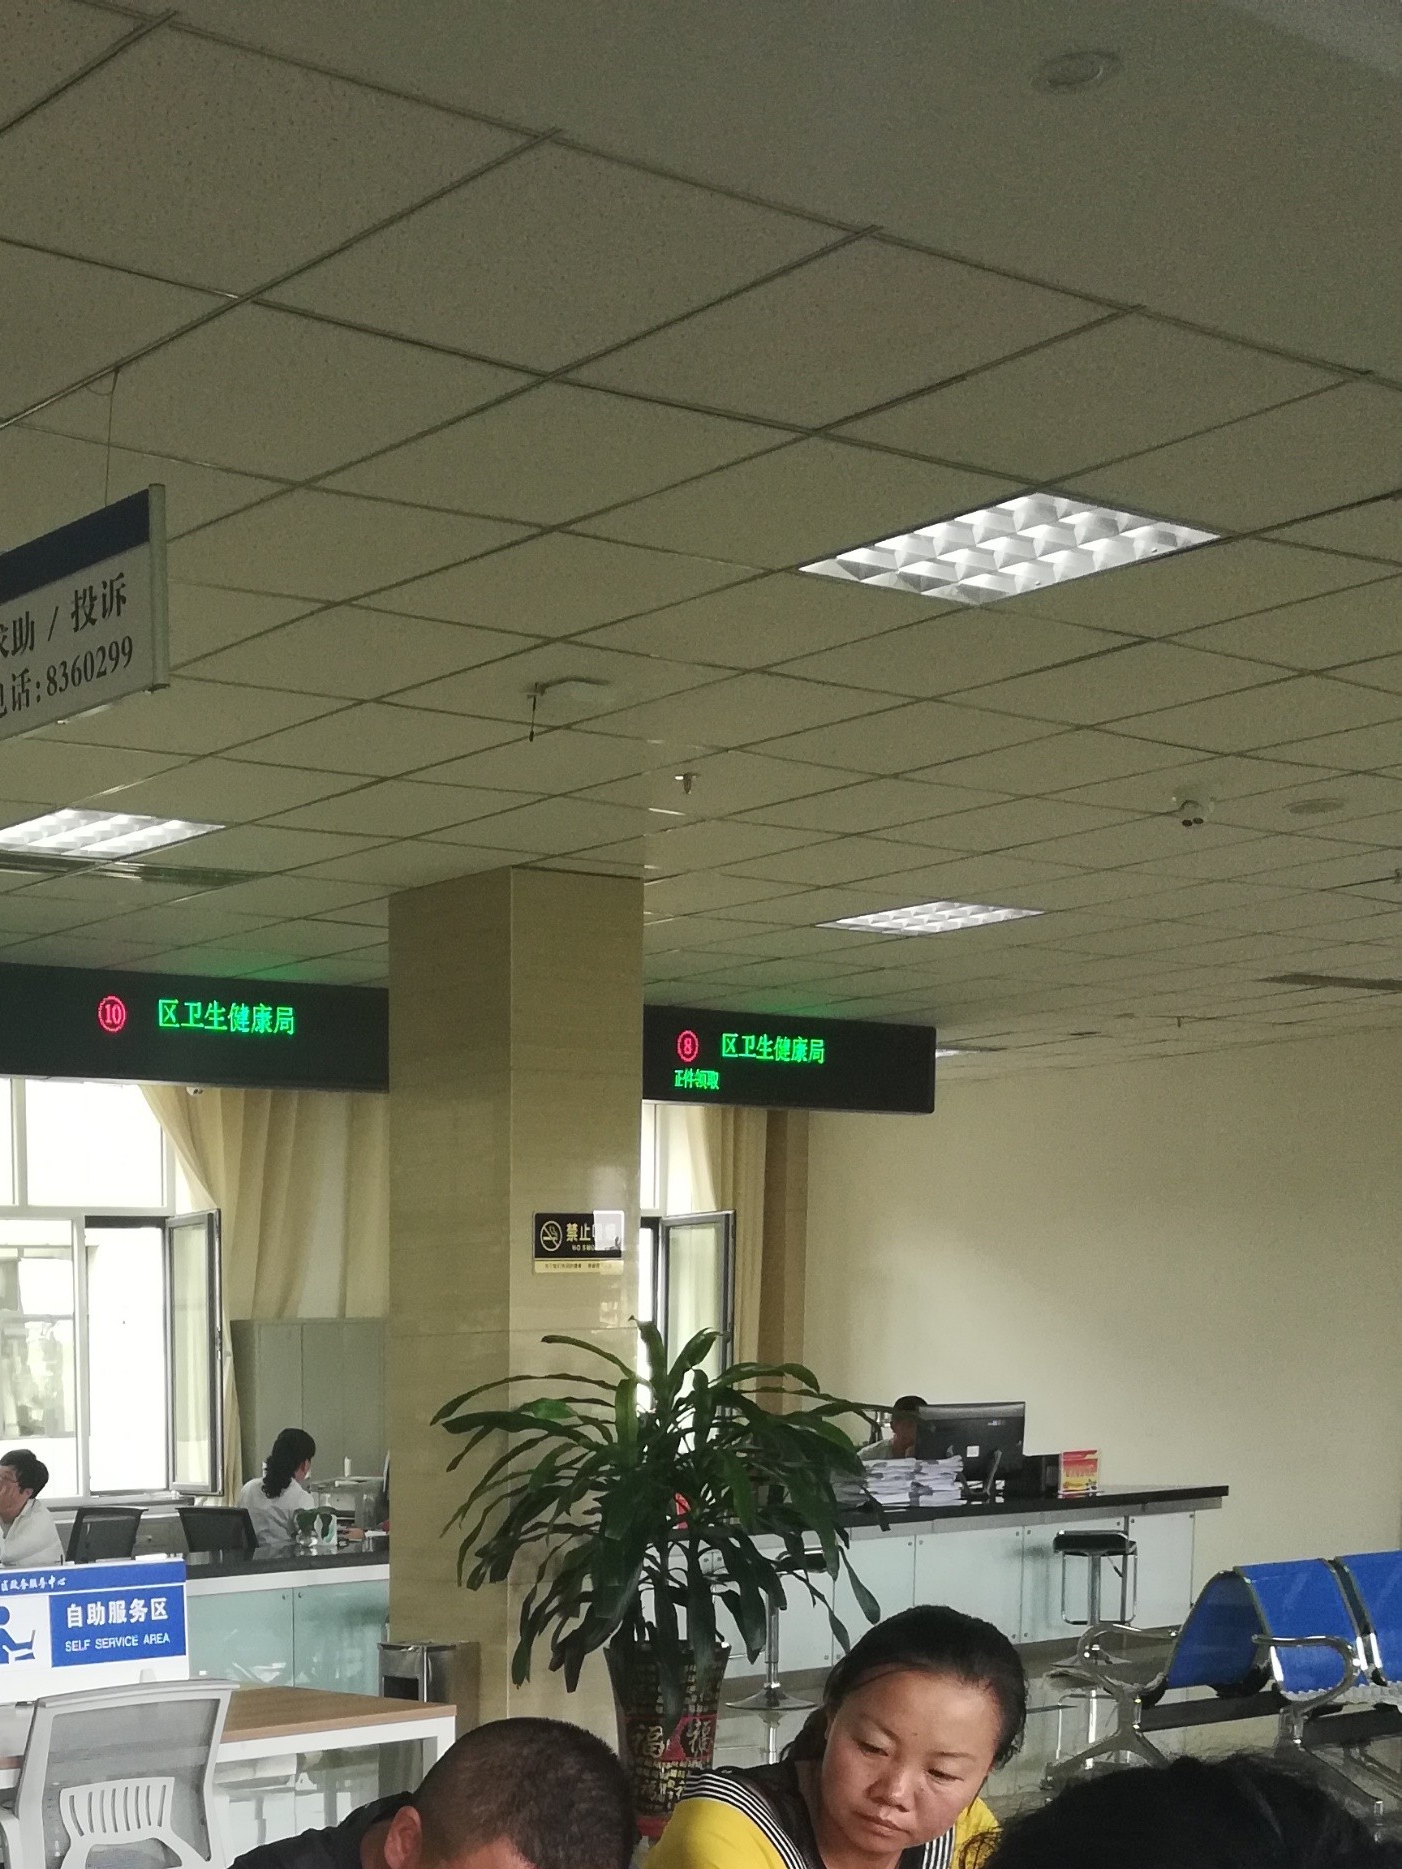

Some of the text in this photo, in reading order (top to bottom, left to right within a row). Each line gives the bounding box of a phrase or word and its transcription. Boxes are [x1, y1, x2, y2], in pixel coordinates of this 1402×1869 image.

[70, 571, 128, 633] 投诉
[158, 998, 295, 1036] 区卫生健康局
[721, 1032, 825, 1065] 区卫生健康局
[66, 1597, 169, 1629] 自助服务区
[65, 1631, 171, 1652] SELF SERVICE AREA
